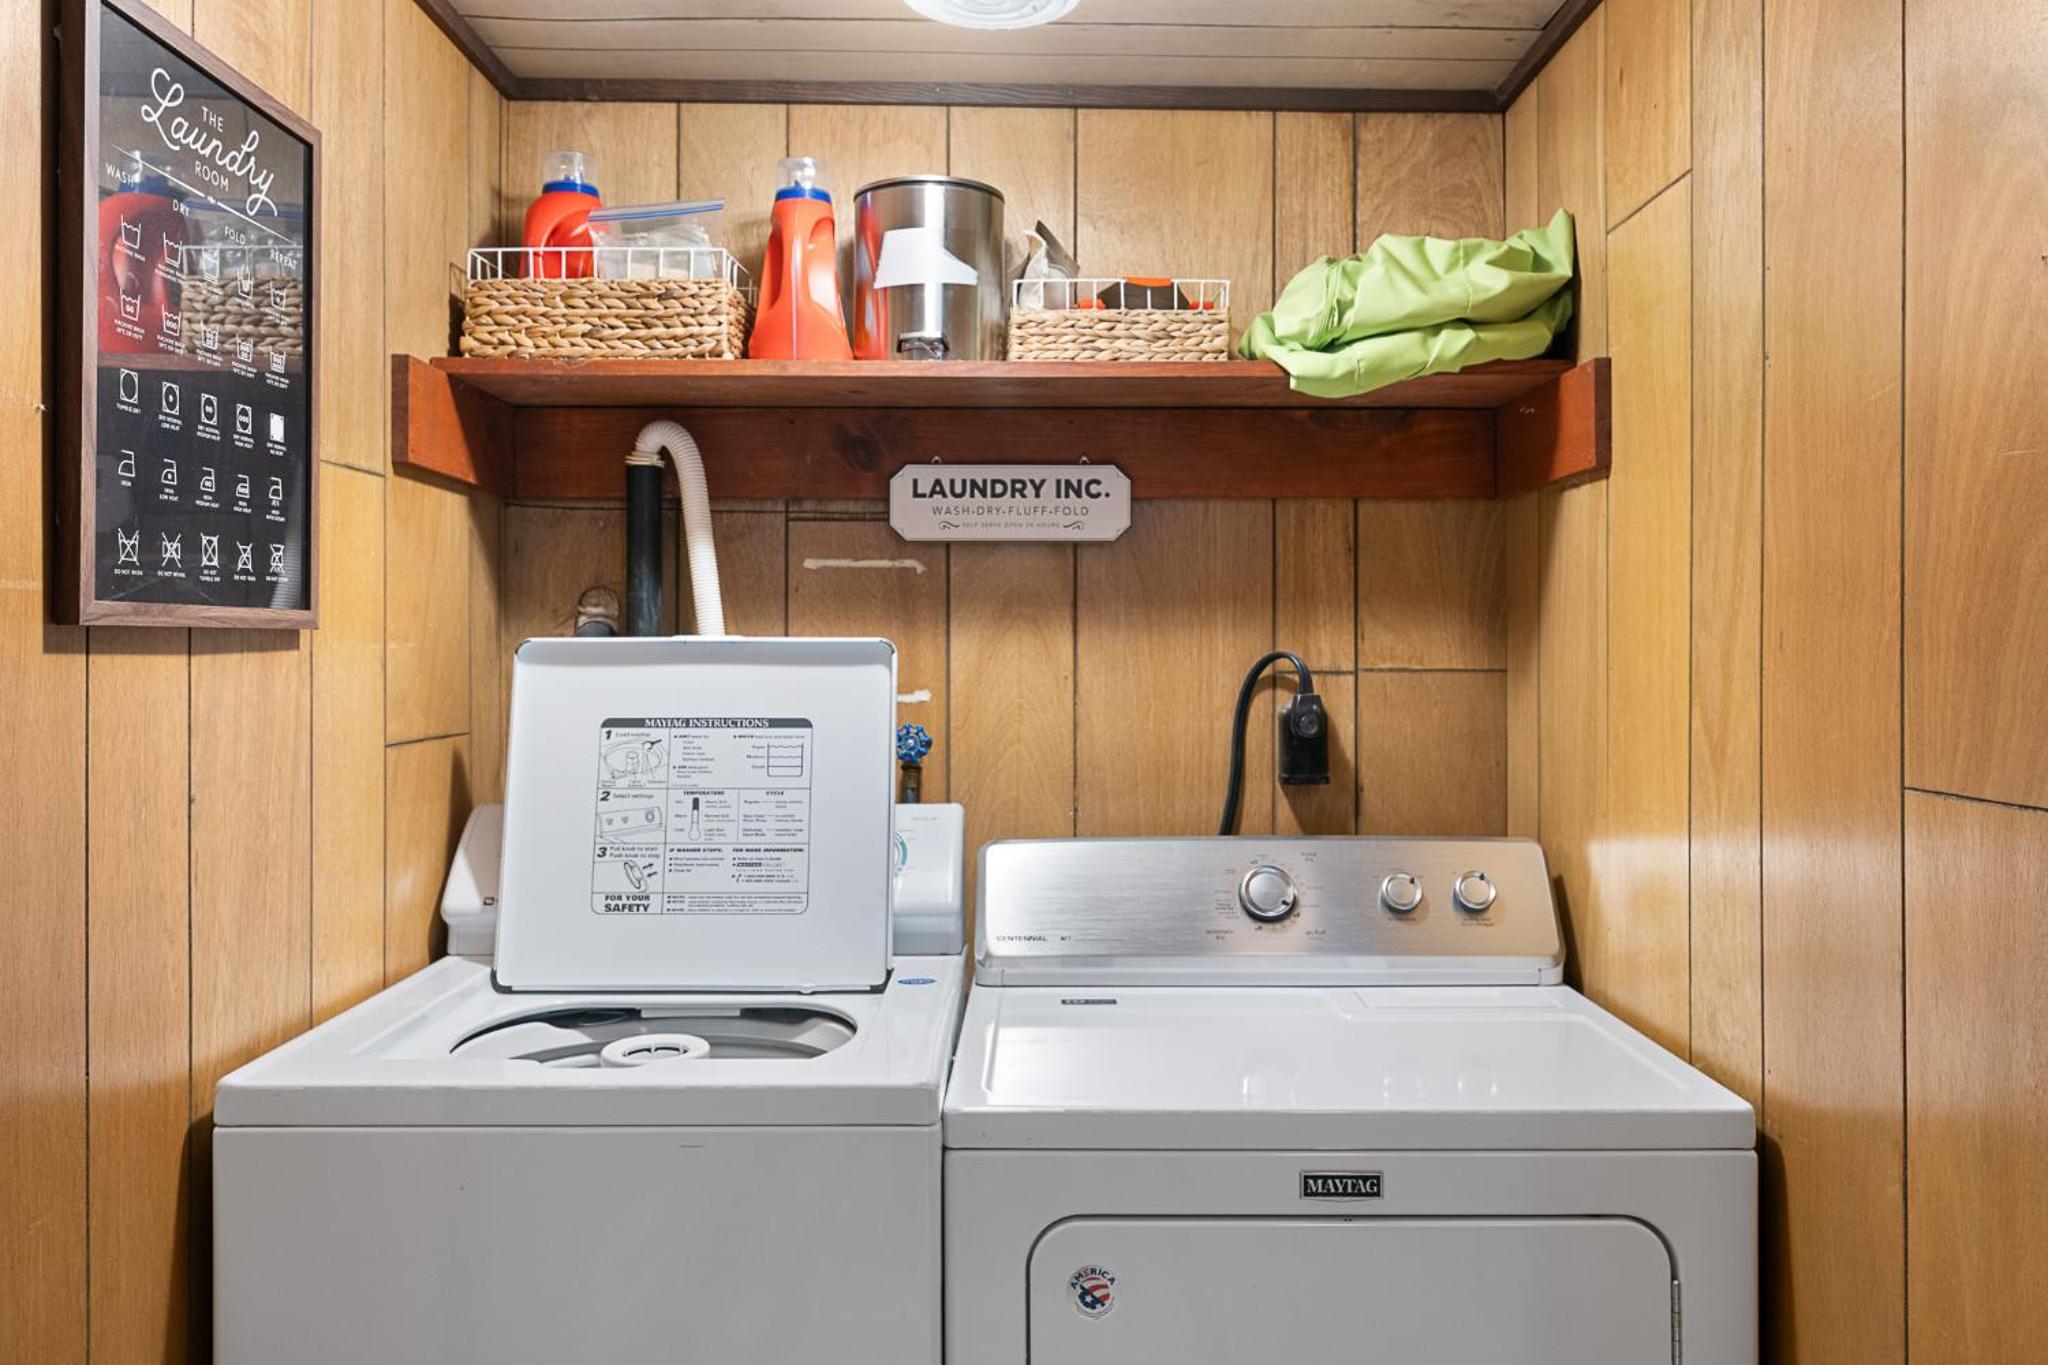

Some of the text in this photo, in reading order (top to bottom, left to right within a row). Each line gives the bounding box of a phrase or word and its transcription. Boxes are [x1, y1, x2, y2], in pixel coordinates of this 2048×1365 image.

[201, 106, 224, 132] THE
[141, 68, 278, 217] Laundry
[106, 163, 134, 188] WASH
[194, 161, 229, 193] ROOM
[172, 199, 191, 217] DRY
[224, 225, 246, 245] FOLD
[270, 248, 298, 270] REPEAT
[912, 478, 1110, 499] LAUNDRY INC.
[932, 505, 1089, 516] WASH DRY FLUFF FOLD
[645, 719, 770, 728] MAYTAG INSTRUCTIONS
[605, 730, 612, 740] 1
[600, 791, 611, 802] 2
[597, 847, 608, 858] 3
[604, 903, 650, 912] SAFETY
[1307, 1178, 1379, 1194] MAYTAG
[1070, 1267, 1116, 1290] AMERICA
